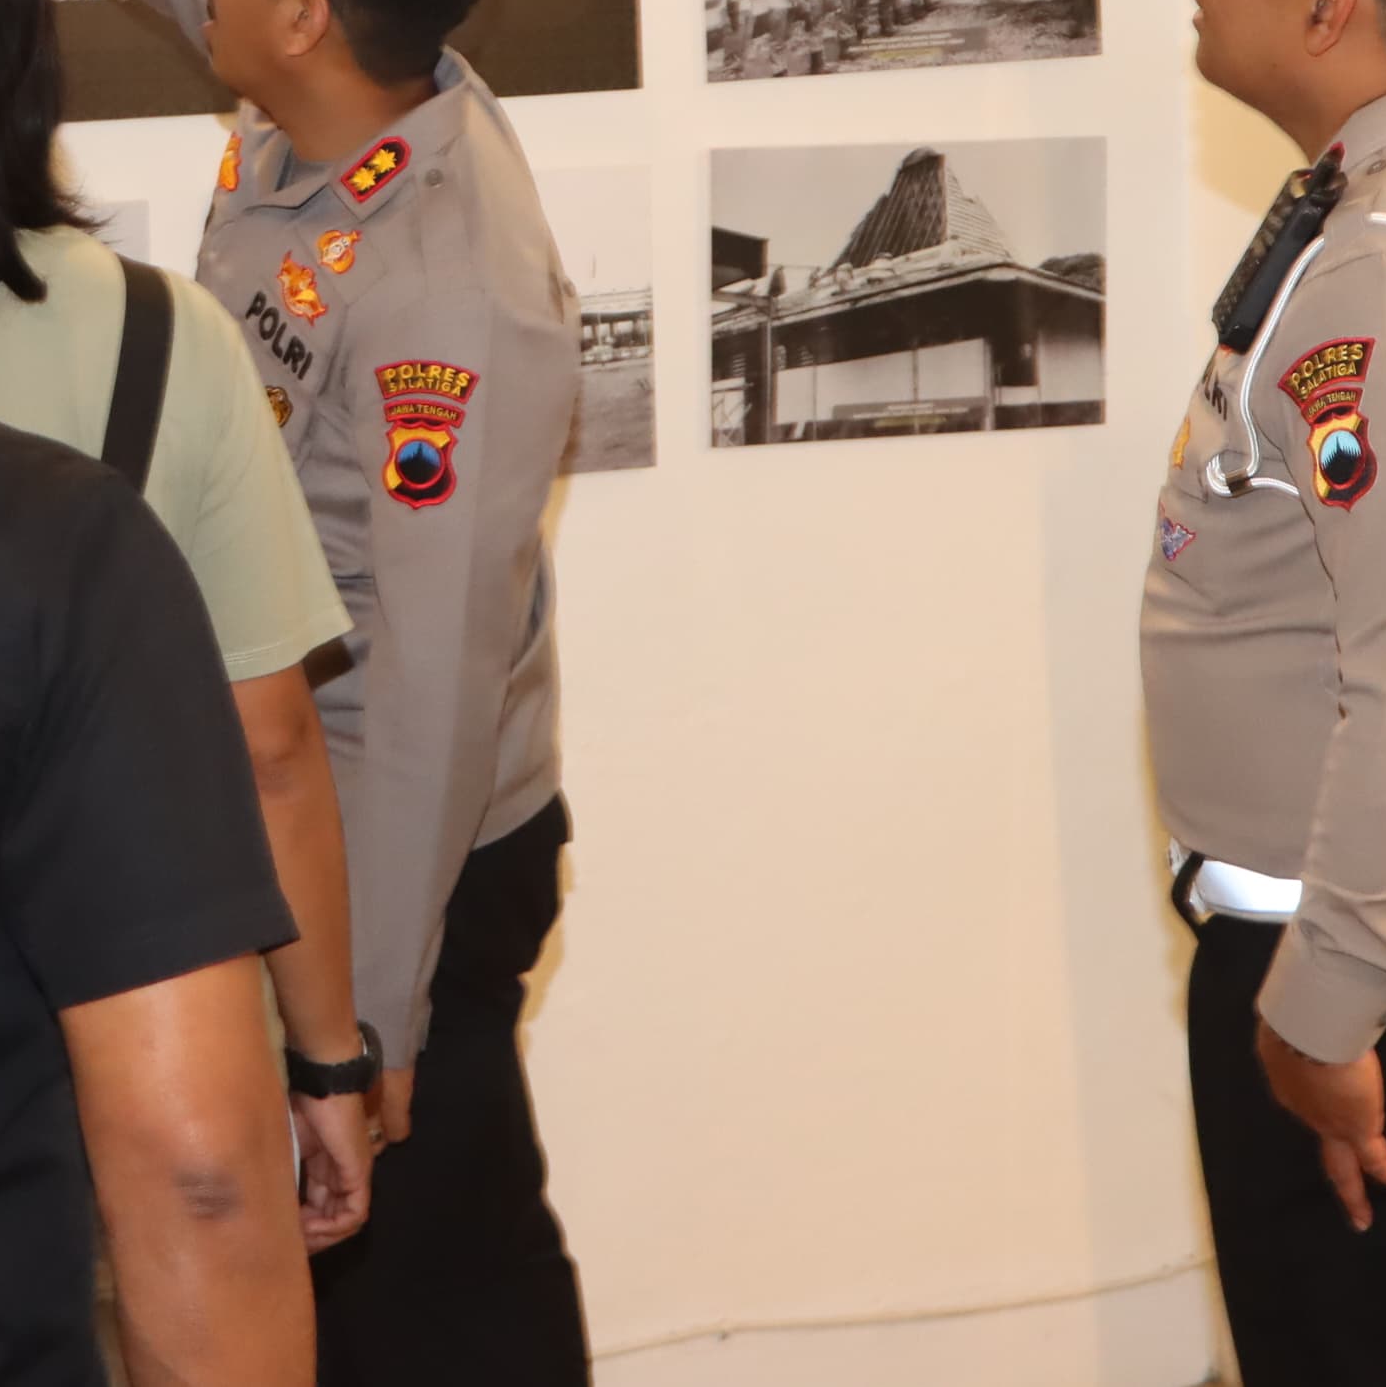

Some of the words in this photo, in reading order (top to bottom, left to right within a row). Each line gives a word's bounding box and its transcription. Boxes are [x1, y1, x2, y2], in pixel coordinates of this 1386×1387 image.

[245, 291, 312, 380] POLRI
[383, 362, 470, 388] POLRES
[1292, 342, 1364, 391] POLRES
[389, 378, 462, 397] SALATIGA
[1299, 361, 1357, 400] SALATIGA
[1327, 390, 1357, 405] TENGAH
[391, 404, 415, 415] JAWA
[417, 404, 458, 420] TENGAH
